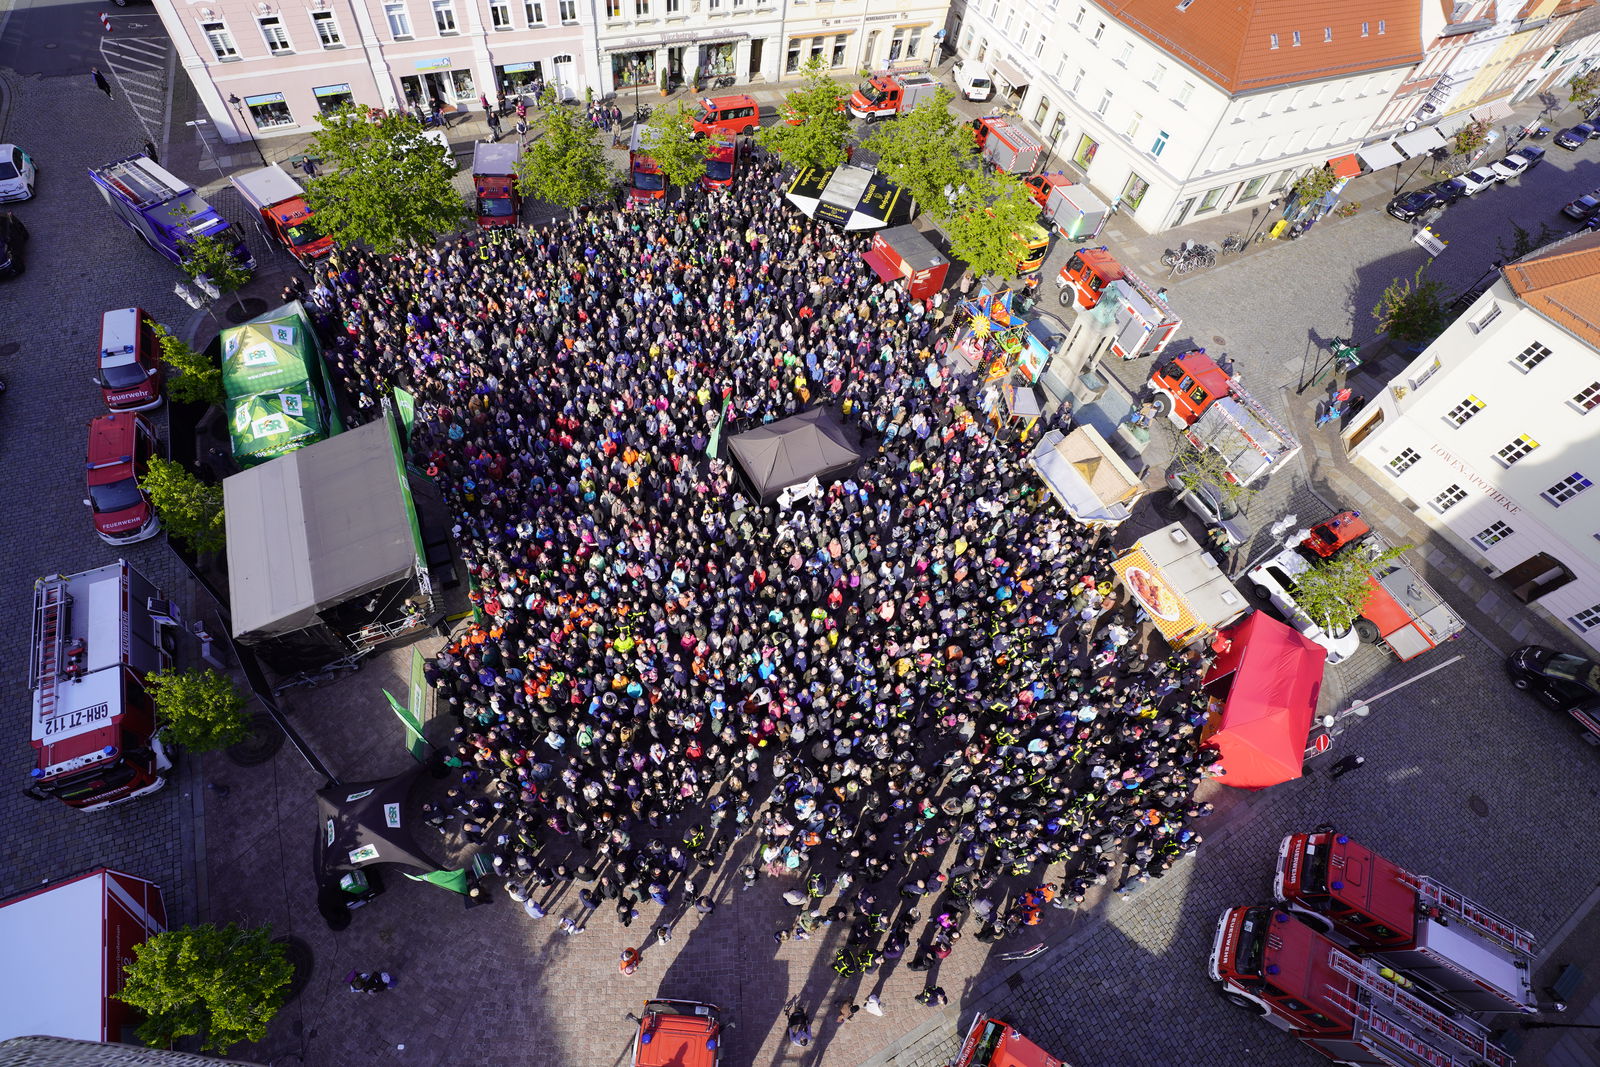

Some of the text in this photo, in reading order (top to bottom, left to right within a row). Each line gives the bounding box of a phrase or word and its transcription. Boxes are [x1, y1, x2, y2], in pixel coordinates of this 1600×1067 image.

[106, 389, 149, 403] Feuerwehr
[276, 441, 305, 452] Sachsen
[102, 515, 142, 530] FEUERWEHR
[121, 610, 129, 656] FEUERWEHR
[45, 702, 109, 736] GRH-ZT 112
[82, 785, 130, 804] FEUERWEHR
[1290, 838, 1302, 885] FEUERWEHR
[1222, 912, 1238, 964] FEUERWEHR
[1426, 950, 1477, 983] FEUERWEHR
